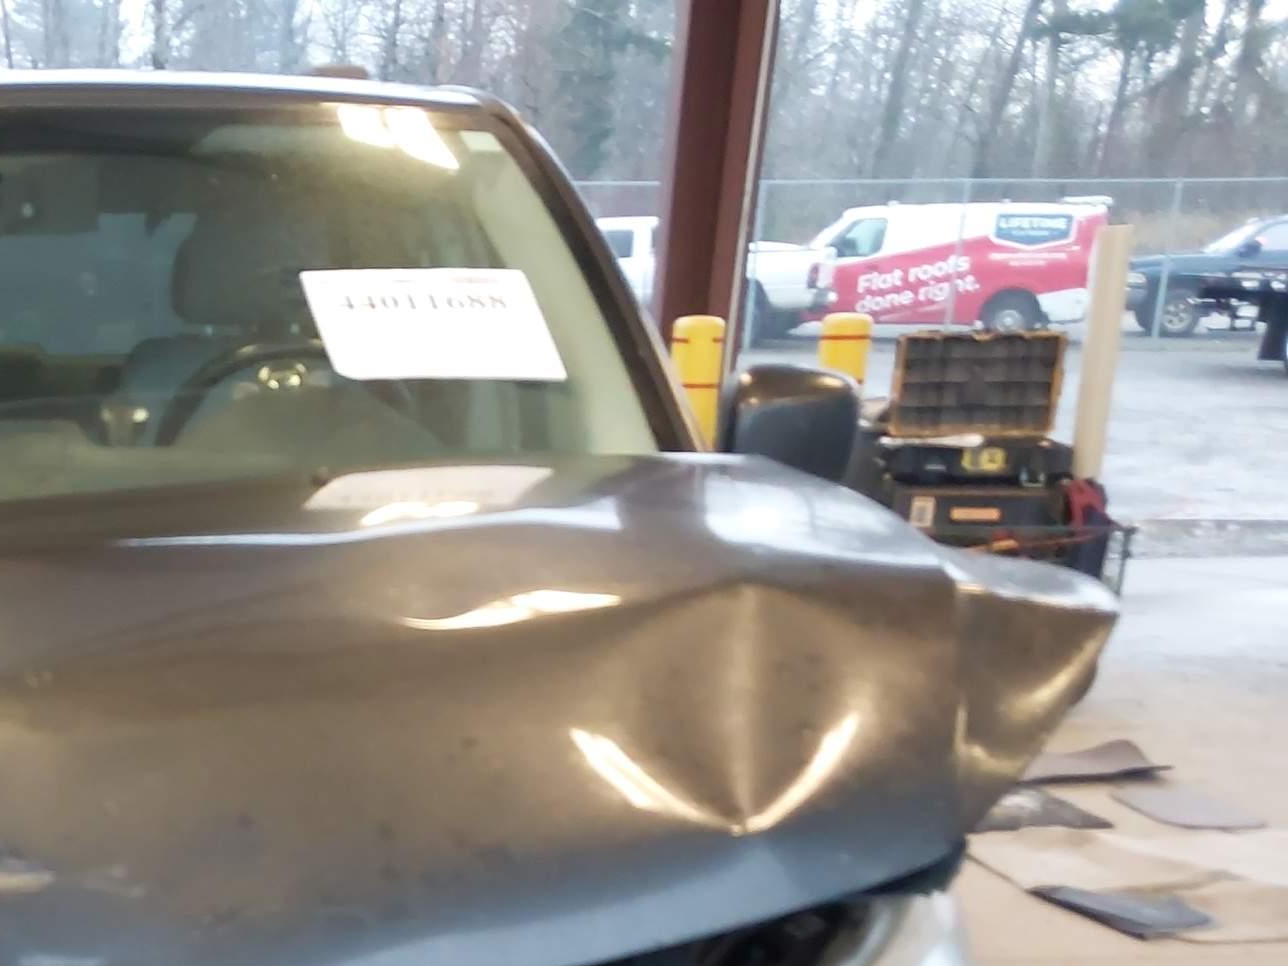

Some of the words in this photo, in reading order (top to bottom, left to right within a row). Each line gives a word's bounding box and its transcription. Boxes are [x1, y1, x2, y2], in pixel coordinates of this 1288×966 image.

[858, 269, 903, 293] Flat
[909, 254, 970, 281] roofs
[857, 290, 914, 312] done
